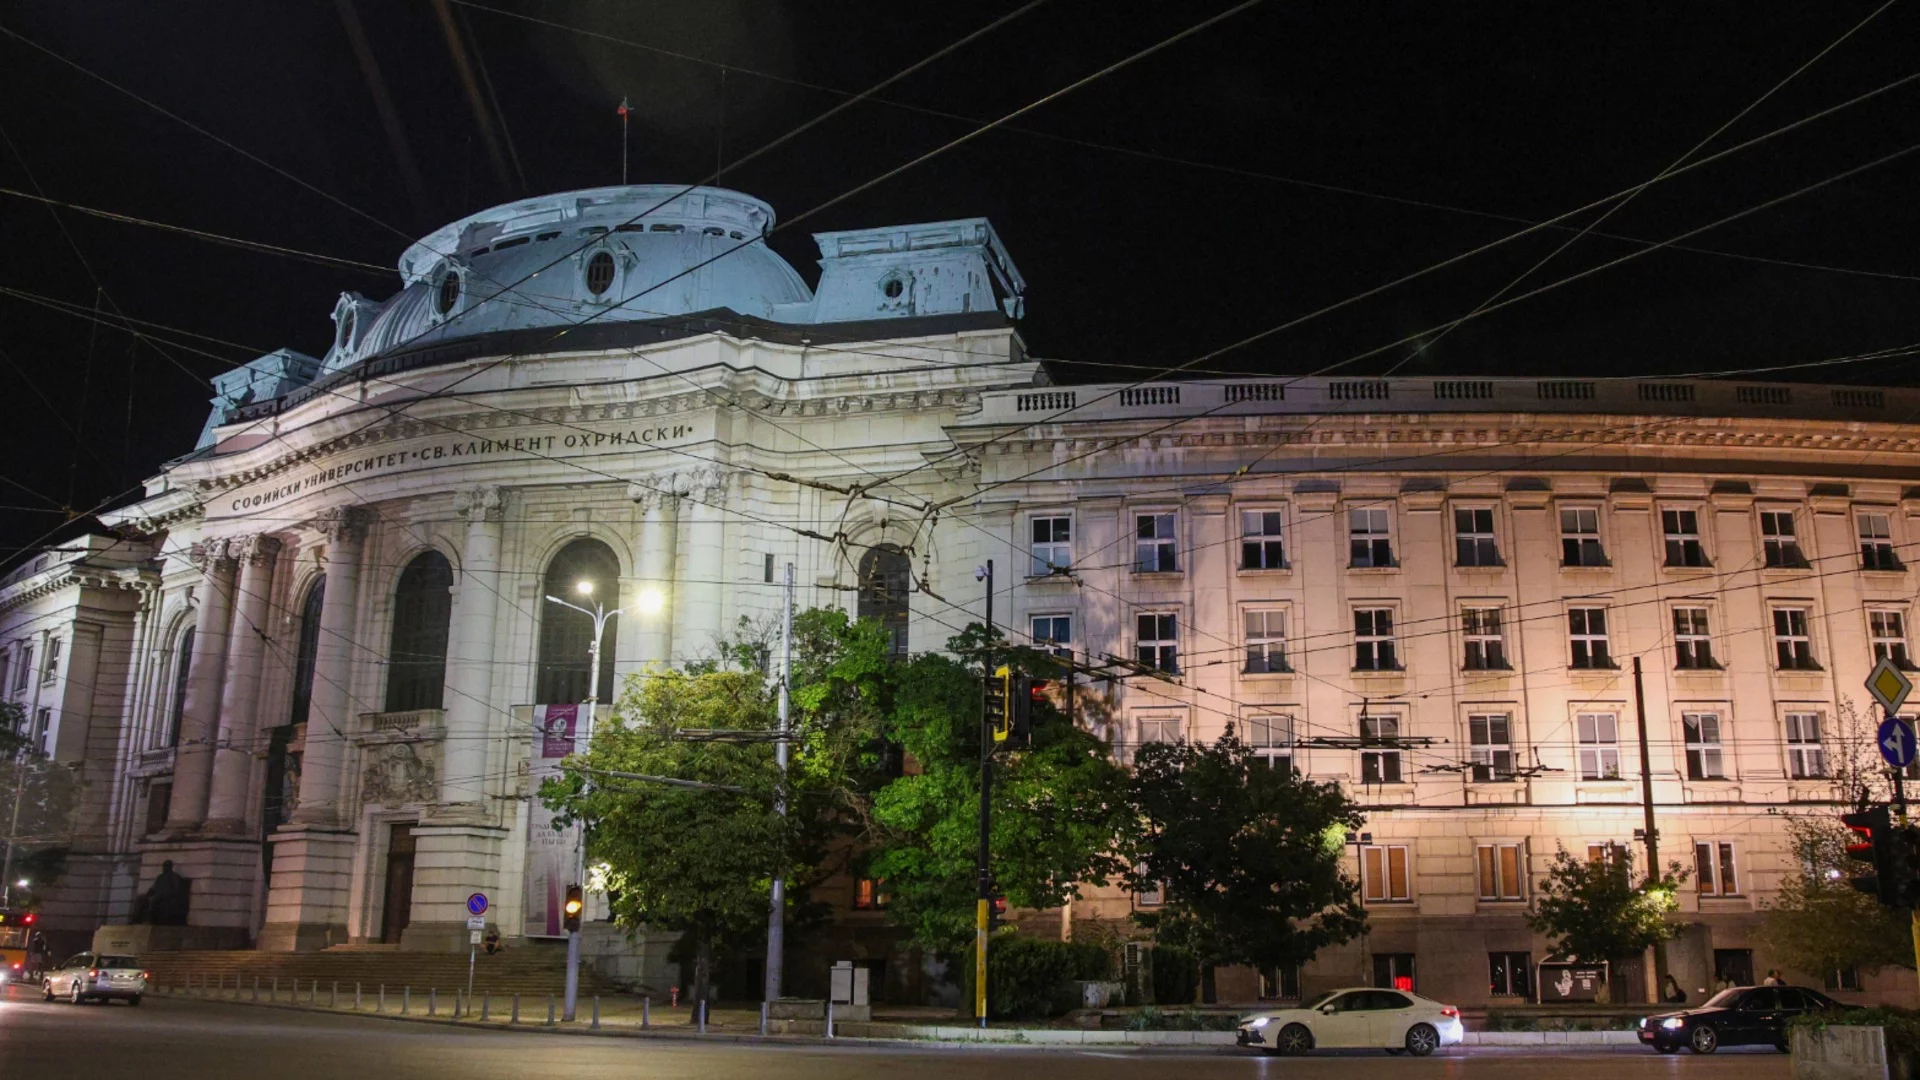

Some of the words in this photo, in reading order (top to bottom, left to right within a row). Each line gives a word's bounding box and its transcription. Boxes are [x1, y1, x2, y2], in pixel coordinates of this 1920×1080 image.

[232, 480, 302, 511] СОФИЙСКИ
[304, 450, 409, 488] УНИВЕРСИТЕТ
[452, 435, 556, 456] КЛИМЕНТ
[564, 424, 685, 448] ОХРИДСКИ
